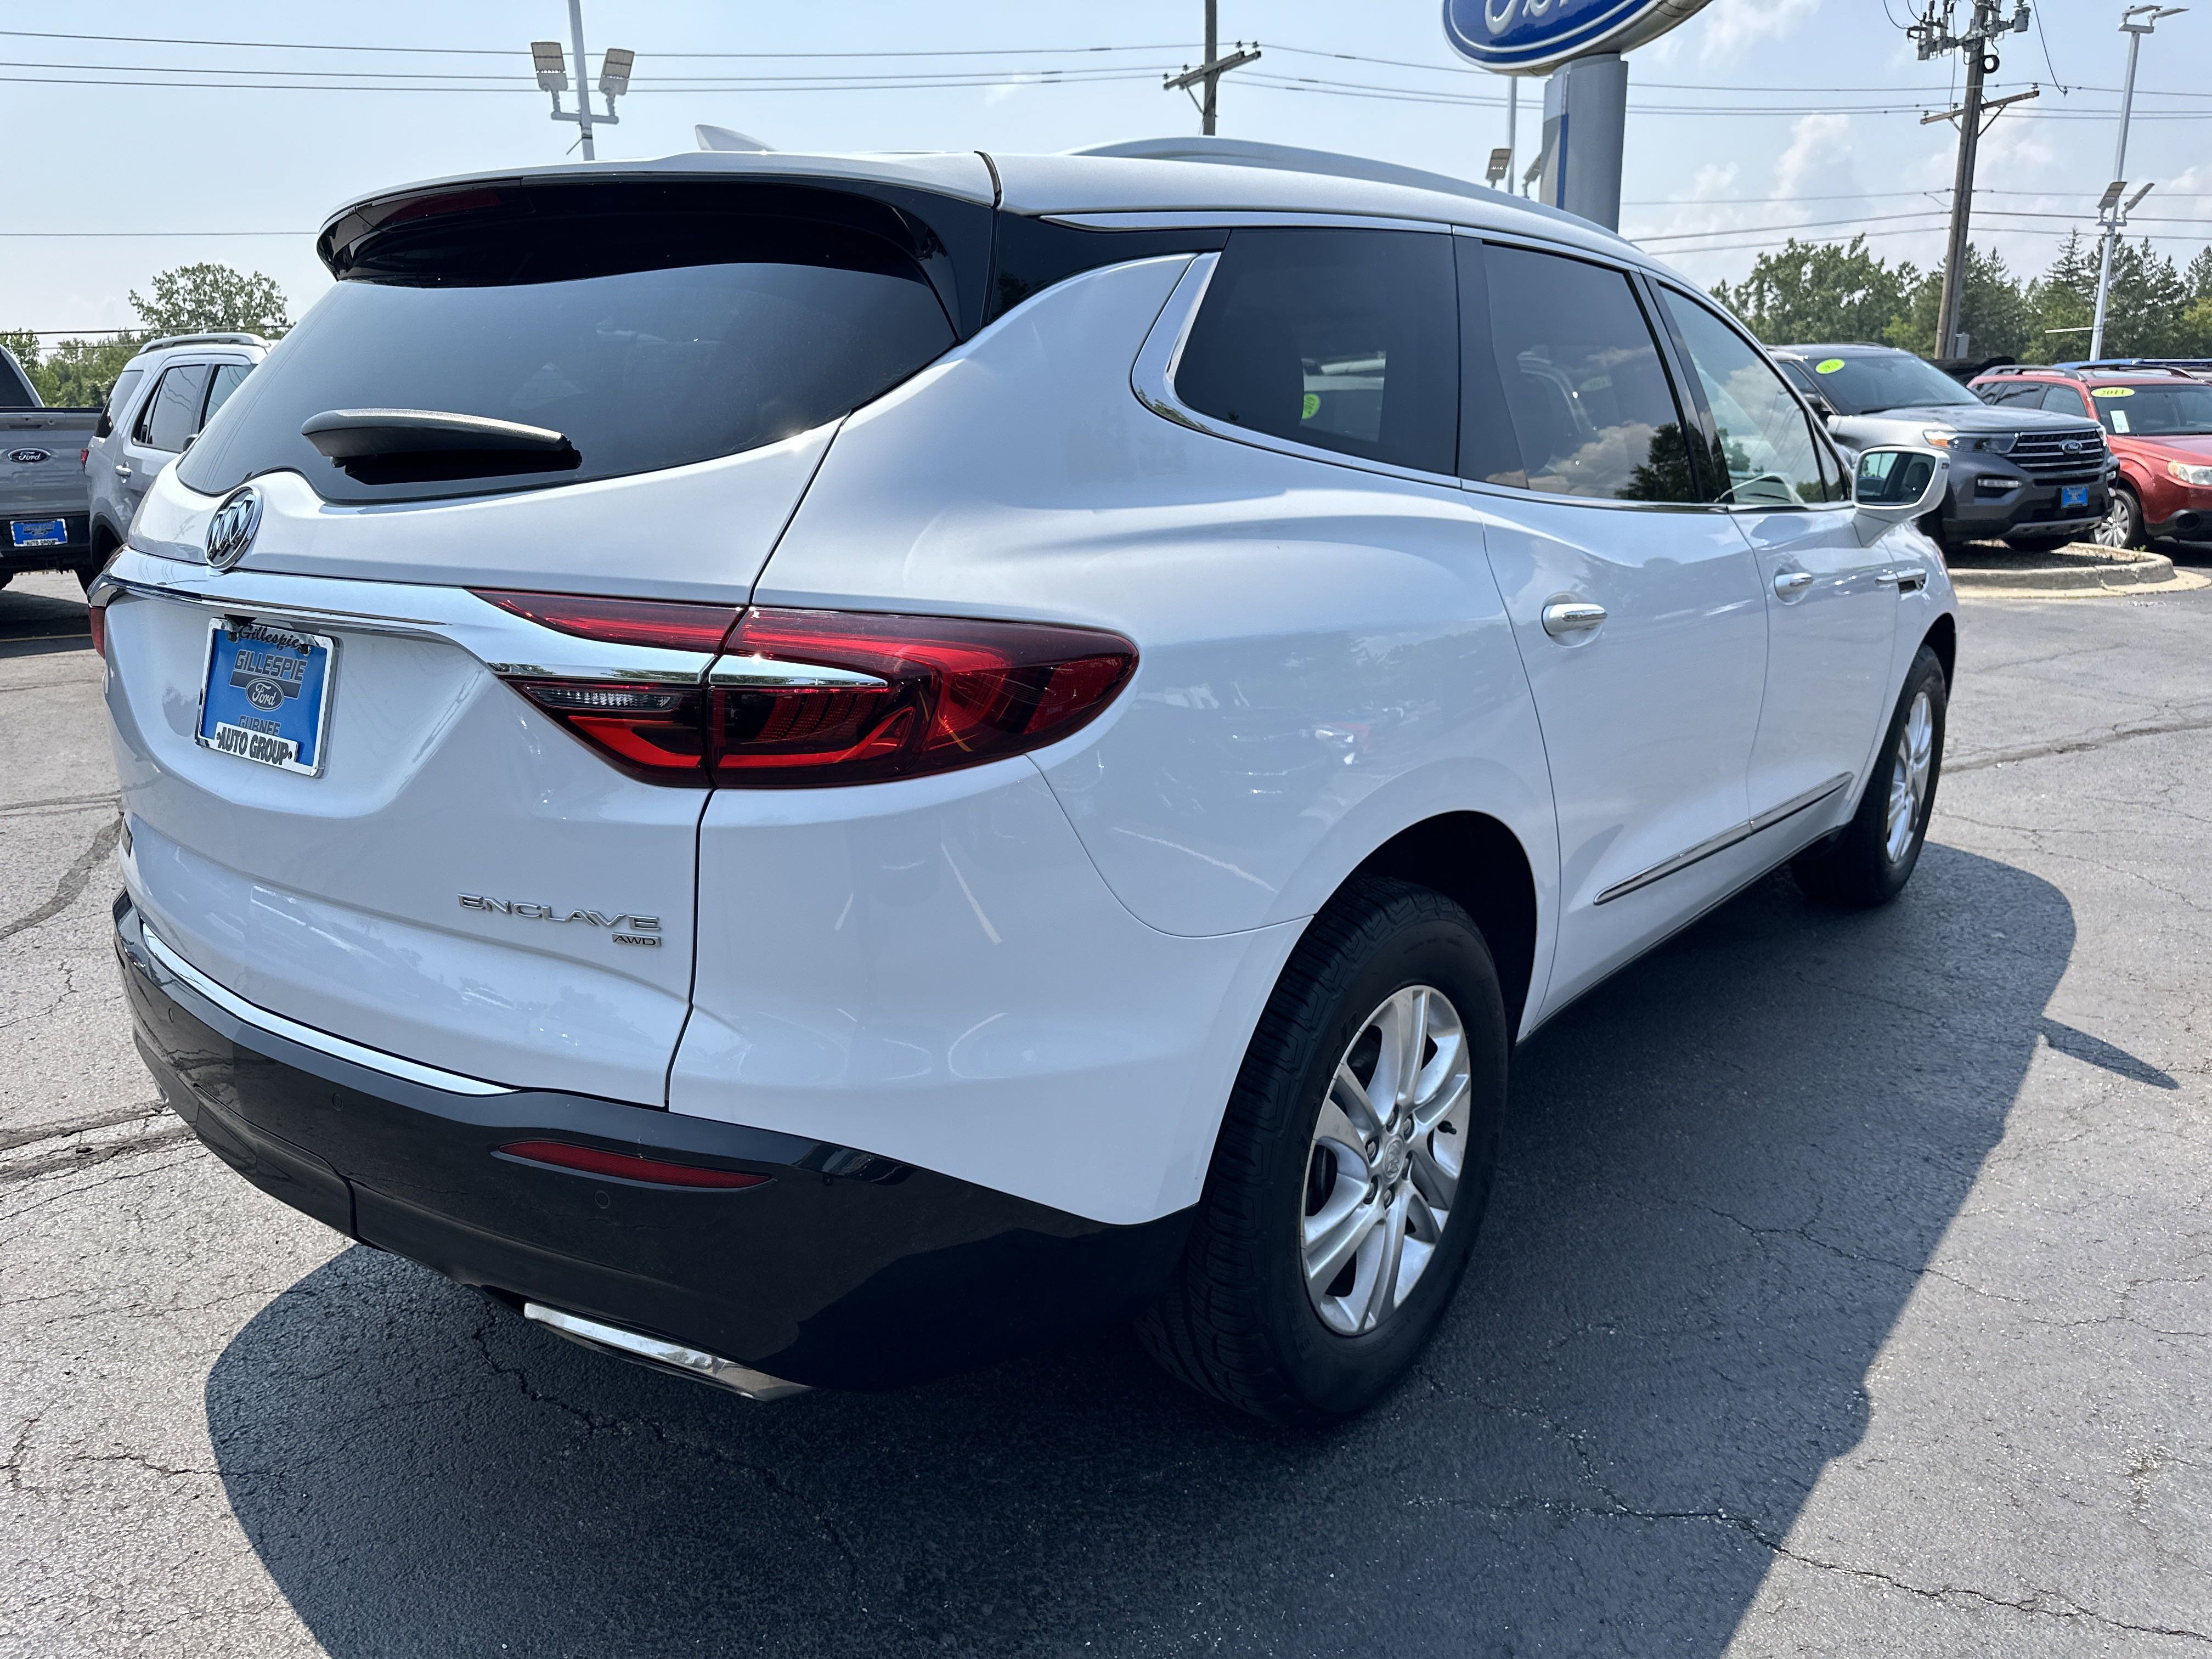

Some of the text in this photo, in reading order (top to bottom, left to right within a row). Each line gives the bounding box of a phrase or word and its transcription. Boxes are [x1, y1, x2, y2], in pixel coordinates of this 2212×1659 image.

[18, 451, 41, 461] Ford
[239, 625, 301, 650] Gillespie
[234, 650, 308, 681] GILLESPIE
[252, 683, 276, 706] Ford
[238, 715, 281, 735] GURNEE
[218, 727, 289, 765] AUTO GROUP
[457, 892, 662, 932] ENCLAVE
[613, 935, 657, 946] AWD
